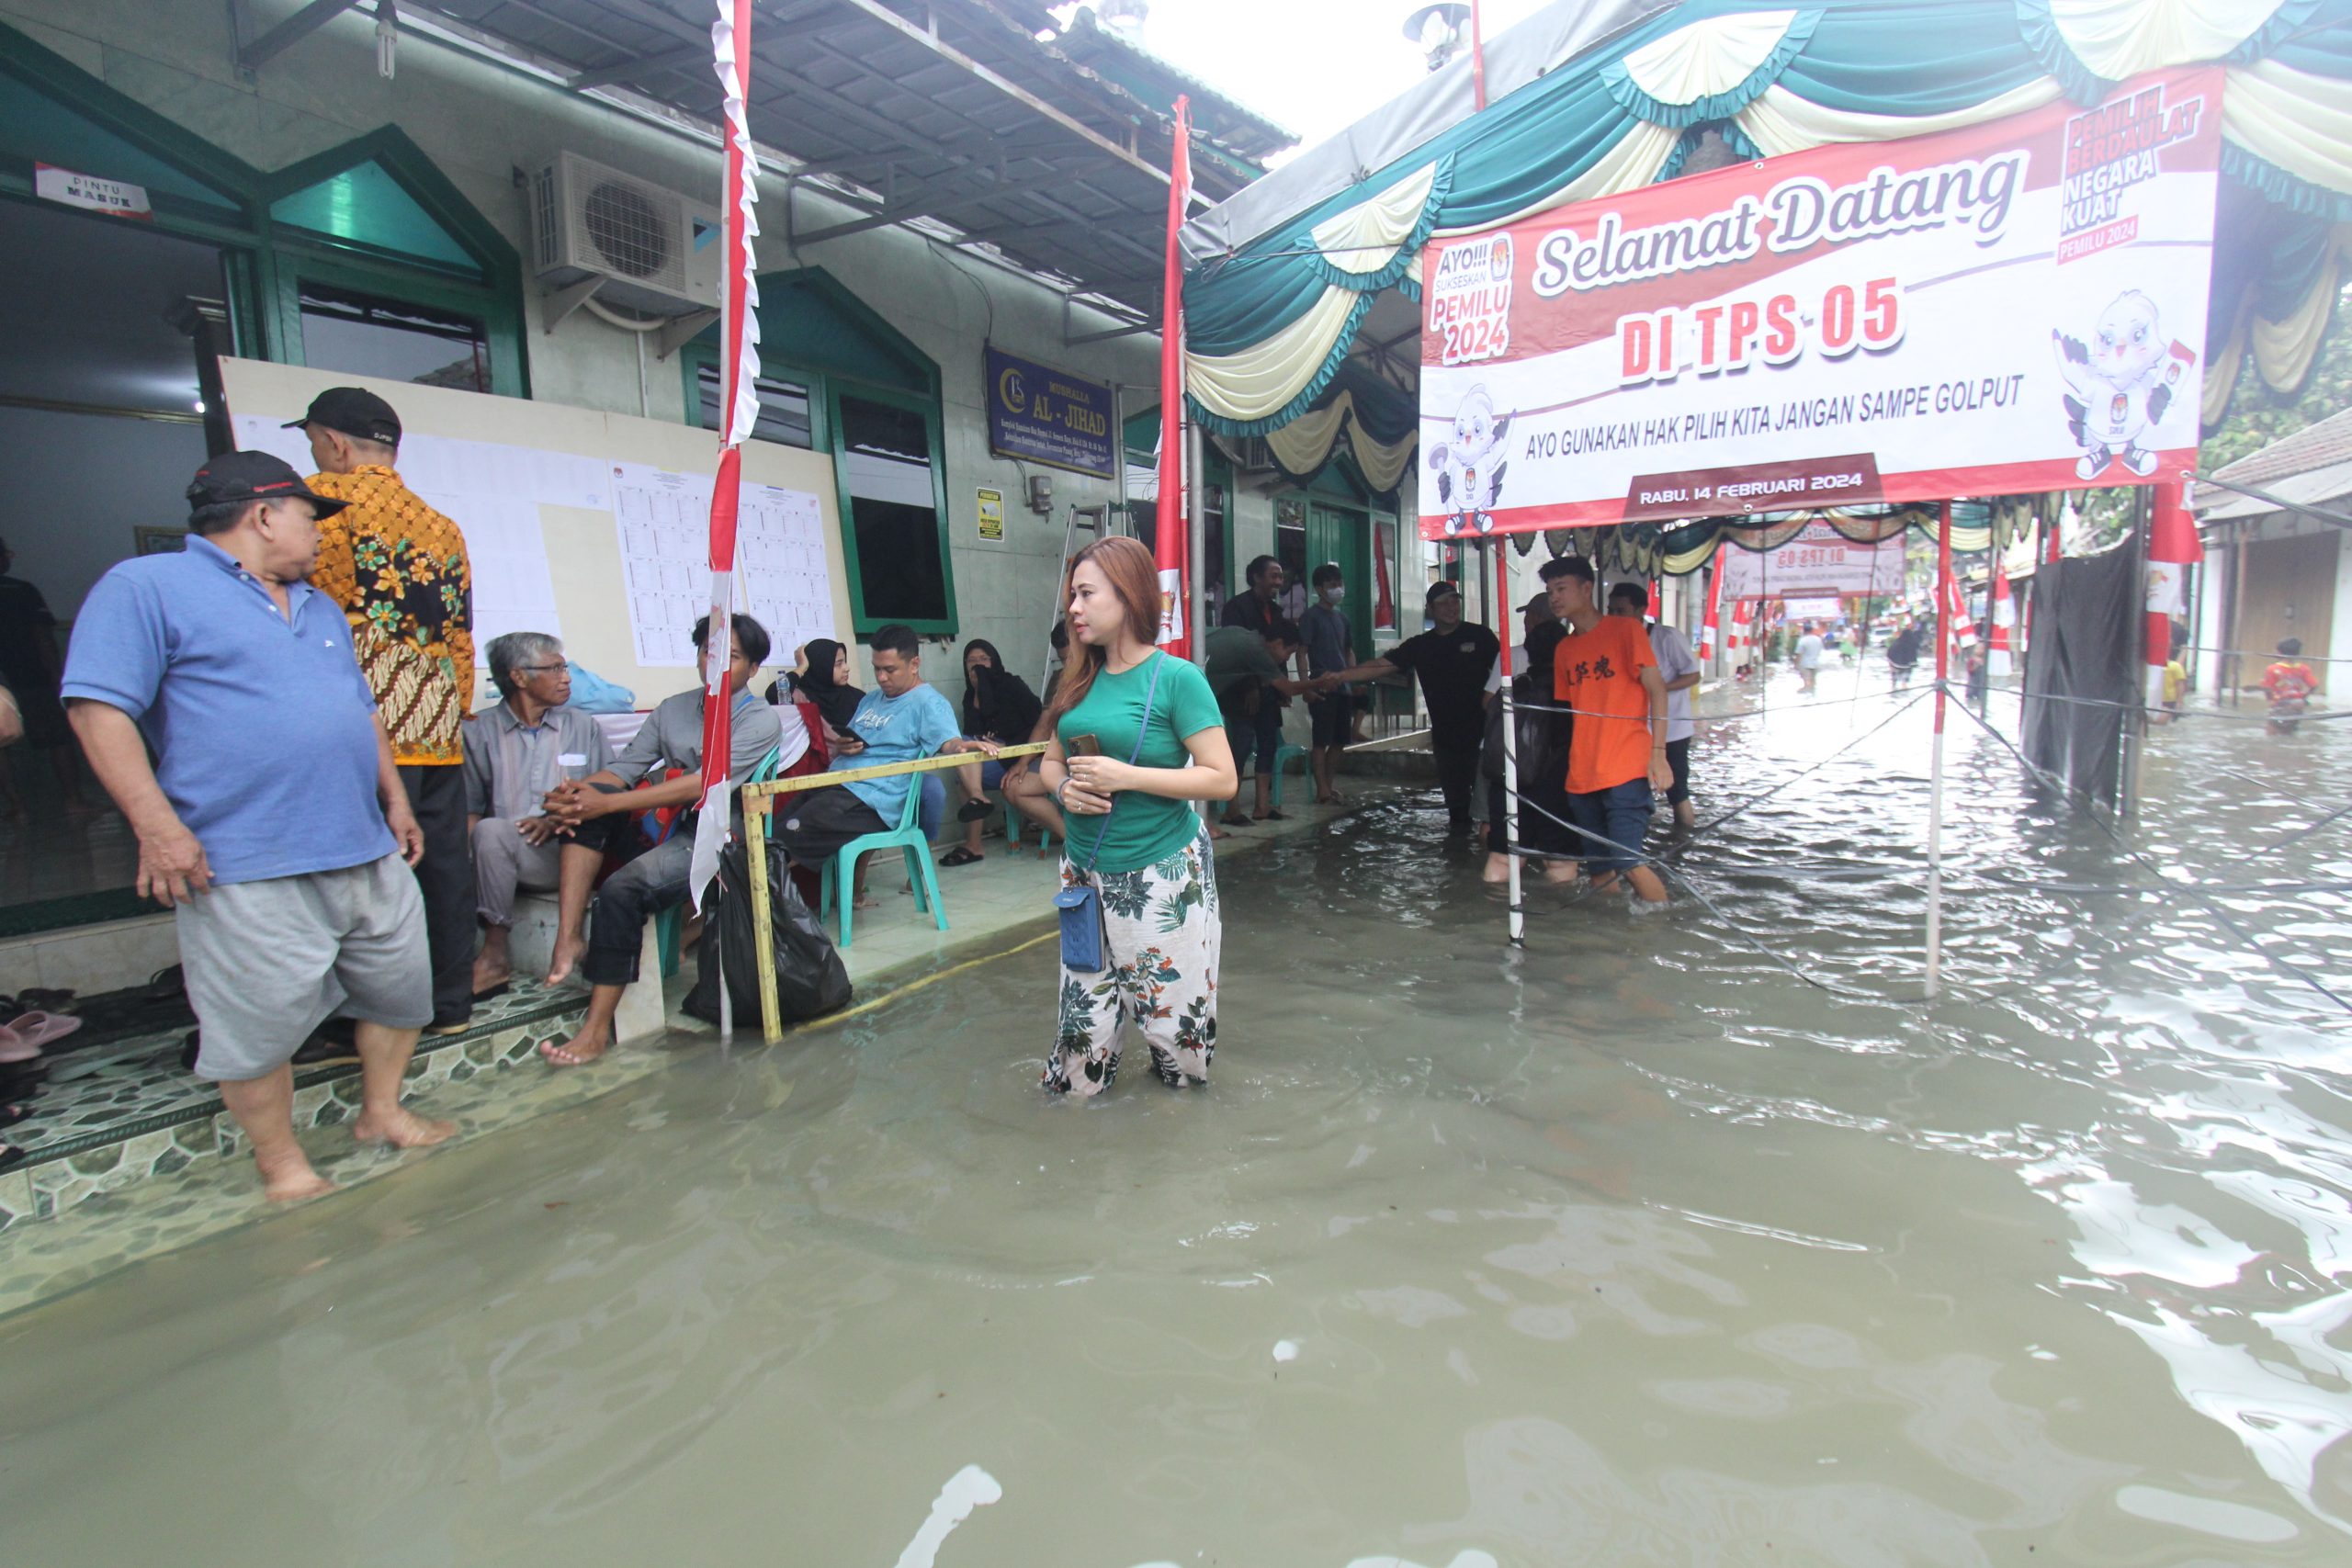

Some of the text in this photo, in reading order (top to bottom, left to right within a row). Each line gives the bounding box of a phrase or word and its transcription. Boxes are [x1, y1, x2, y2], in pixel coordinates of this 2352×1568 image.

[2070, 86, 2160, 144] PEMILIH
[2069, 99, 2200, 175] BERDAULAT
[67, 186, 131, 208] MASUK
[2064, 149, 2156, 204] NEGARA
[1540, 158, 2020, 288] Selamat Datang
[2062, 188, 2121, 233] KUAT
[1440, 244, 1487, 275] AYO!!!
[2060, 220, 2135, 260] PEMILU 2024
[1435, 271, 1487, 292] SUKSESKAN
[1433, 285, 1508, 325] PEMILU
[1446, 316, 1506, 358] 2024
[1623, 277, 1898, 378] DI TPS 05
[1033, 394, 1052, 422] AL
[1065, 404, 1105, 436] JIHAD
[1526, 374, 2024, 459] AYO GUNAKAN HAK PILIH KITA JANGAN SAMPE GOLPUT
[1694, 487, 1711, 500] 14
[1716, 479, 1805, 498] FEBRUARI
[1811, 473, 1863, 491] 2024
